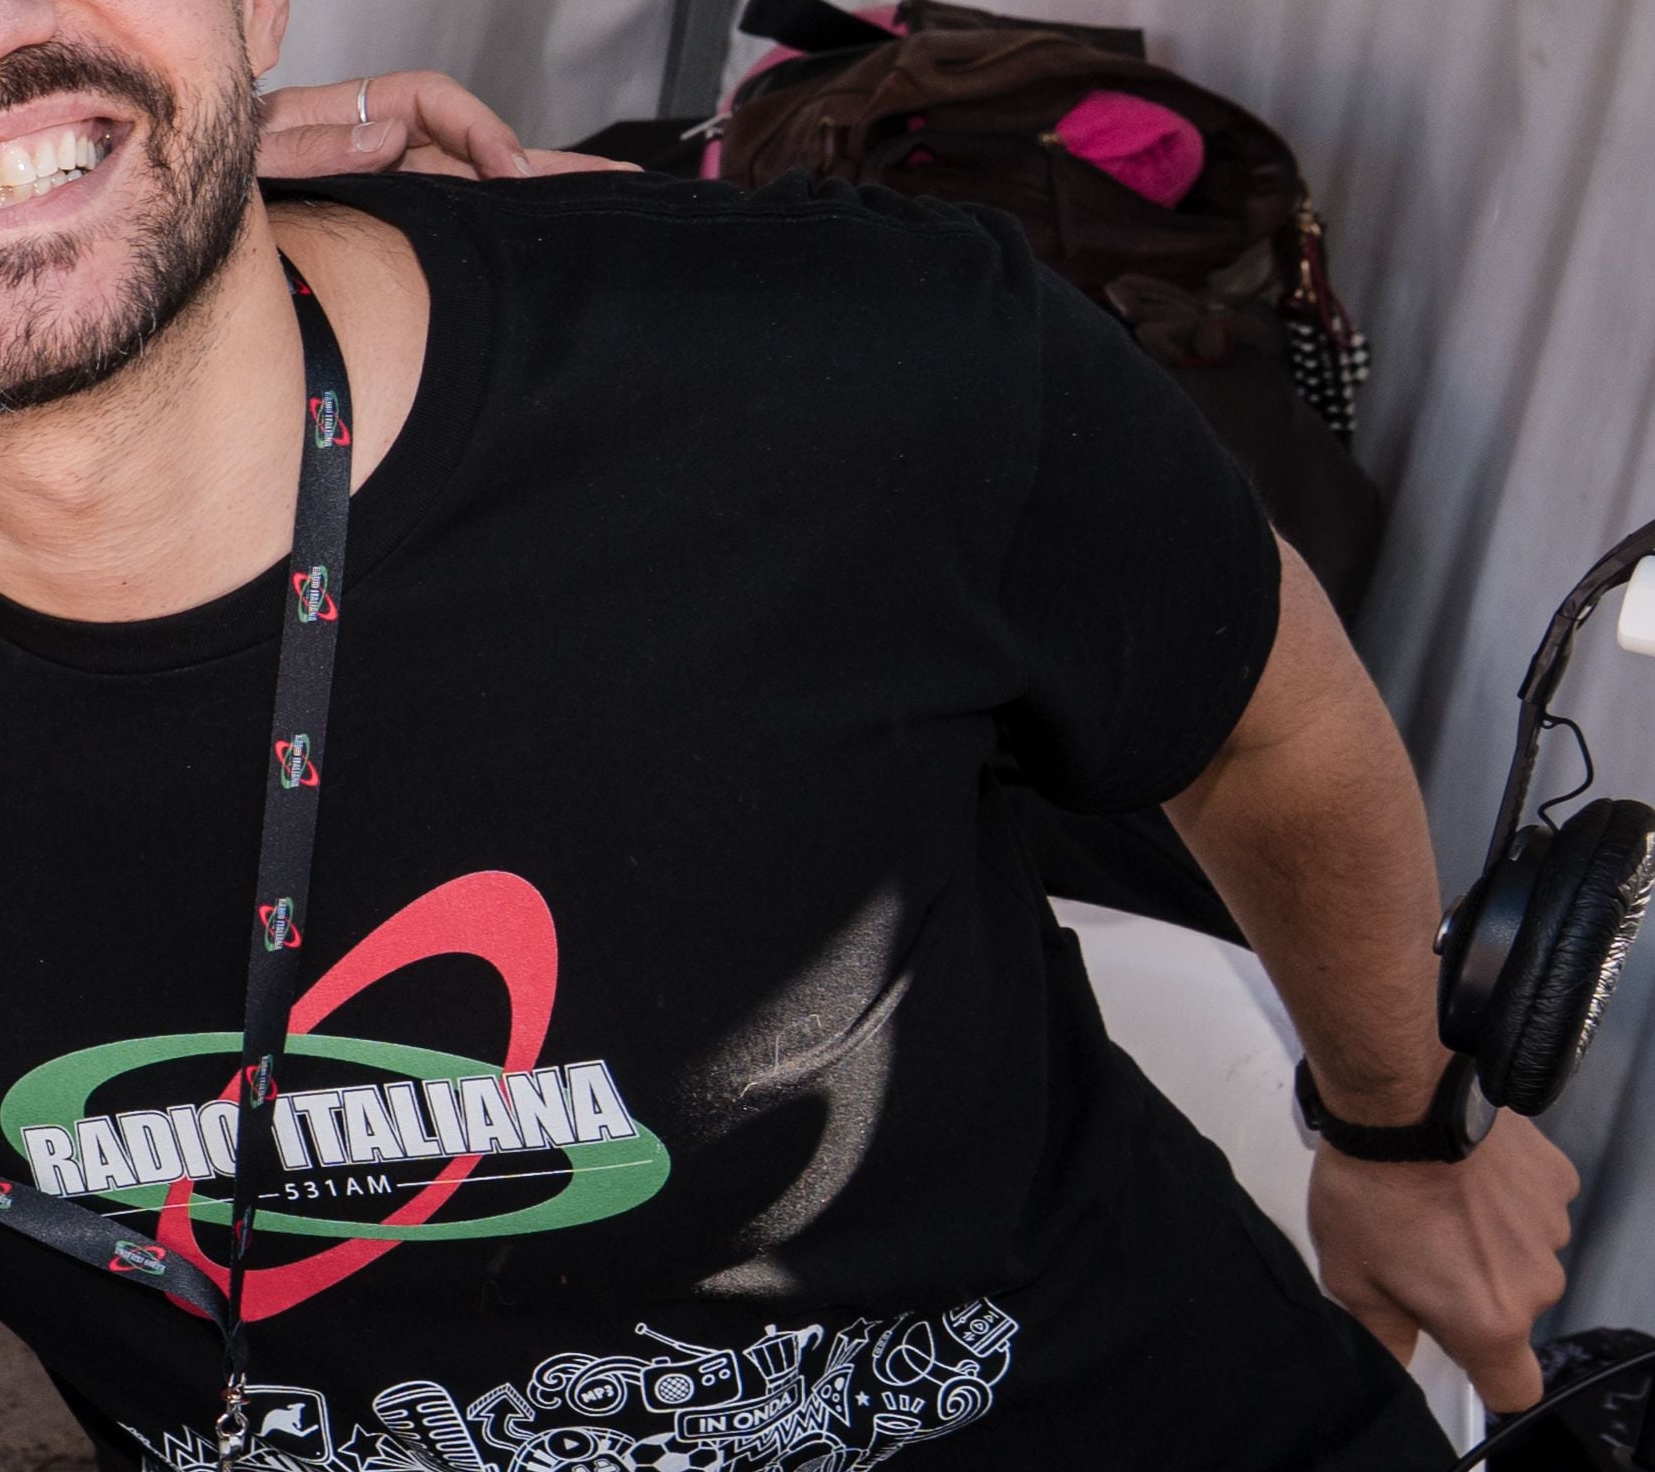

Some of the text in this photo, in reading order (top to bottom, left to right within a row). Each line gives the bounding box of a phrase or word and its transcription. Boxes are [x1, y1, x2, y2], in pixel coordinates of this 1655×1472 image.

[22, 1060, 639, 1199] RADIO ITALIANA
[580, 1383, 616, 1404] MP3
[698, 1391, 794, 1435] IN ONDA
